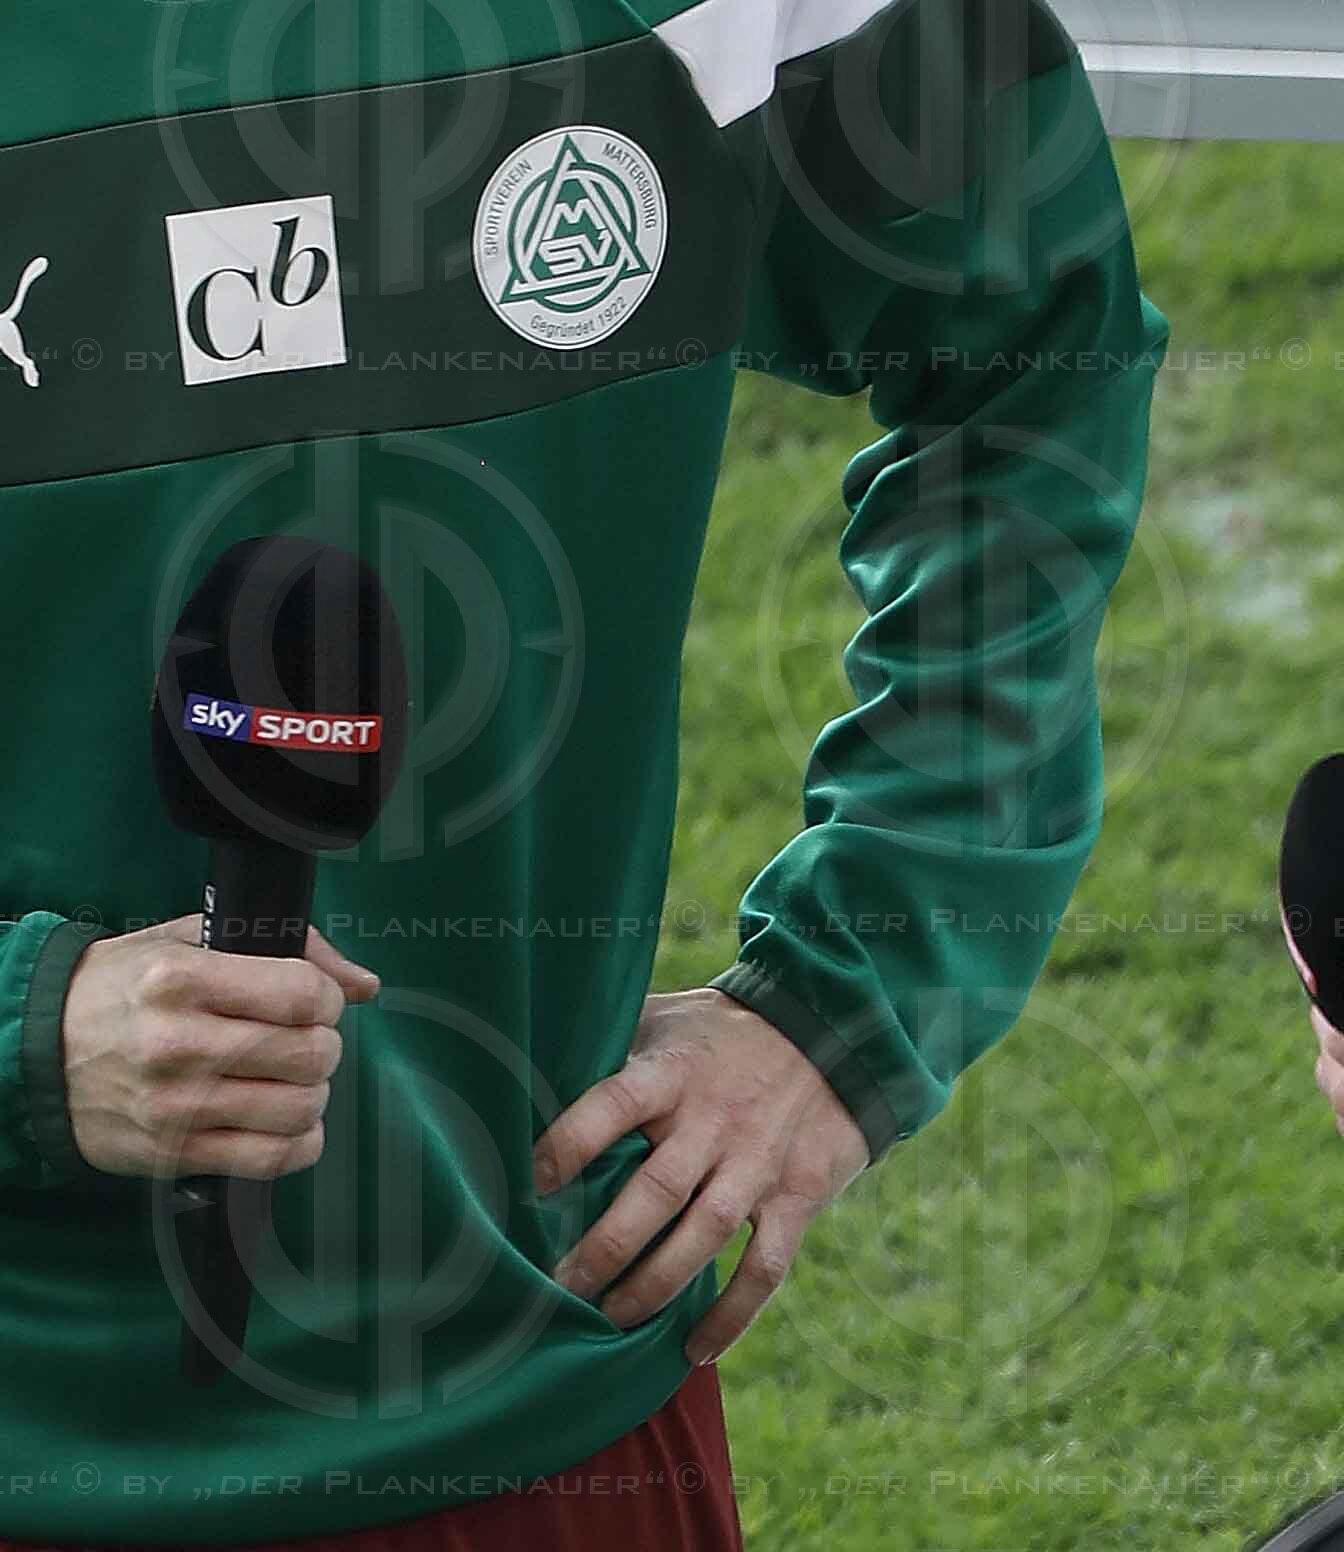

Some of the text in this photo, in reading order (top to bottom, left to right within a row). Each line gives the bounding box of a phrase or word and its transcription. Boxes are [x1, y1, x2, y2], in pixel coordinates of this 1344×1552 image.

[486, 159, 534, 257] SPORTVEREIN
[602, 142, 658, 230] MATTERSBURG
[597, 295, 628, 327] 1922
[191, 701, 377, 746] sky SPORT
